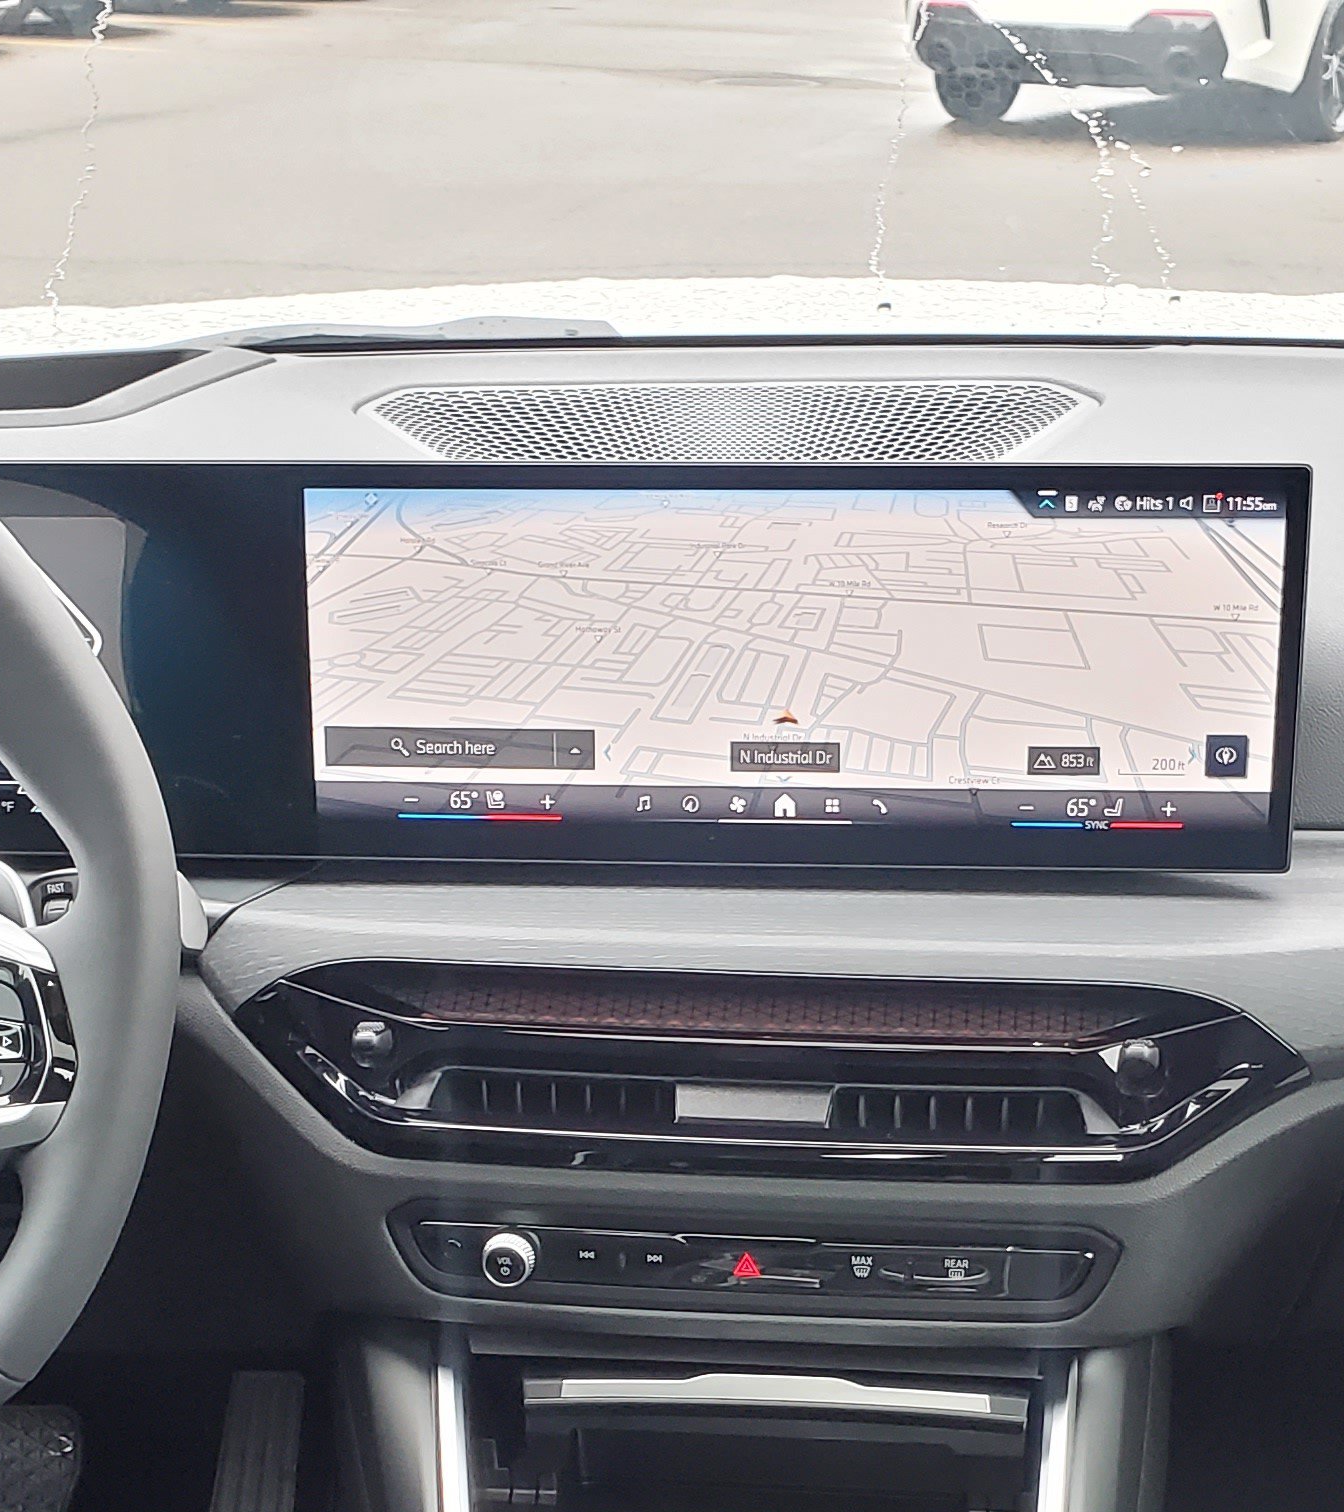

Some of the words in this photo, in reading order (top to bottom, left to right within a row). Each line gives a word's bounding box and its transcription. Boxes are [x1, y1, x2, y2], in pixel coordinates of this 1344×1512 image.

[1136, 496, 1163, 511] Hits
[416, 740, 462, 755] Search
[464, 741, 495, 755] here
[739, 750, 751, 764] N
[753, 750, 813, 765] Industrial
[816, 750, 833, 765] Dr
[1060, 753, 1084, 767] 853
[1085, 756, 1094, 767] ft
[1152, 758, 1176, 771] 200
[1177, 761, 1186, 771] ft
[1084, 820, 1109, 830] SYNC
[46, 882, 65, 894] FAST
[496, 1256, 512, 1265] VOL
[851, 1255, 873, 1266] MAX
[944, 1259, 969, 1269] REAR
